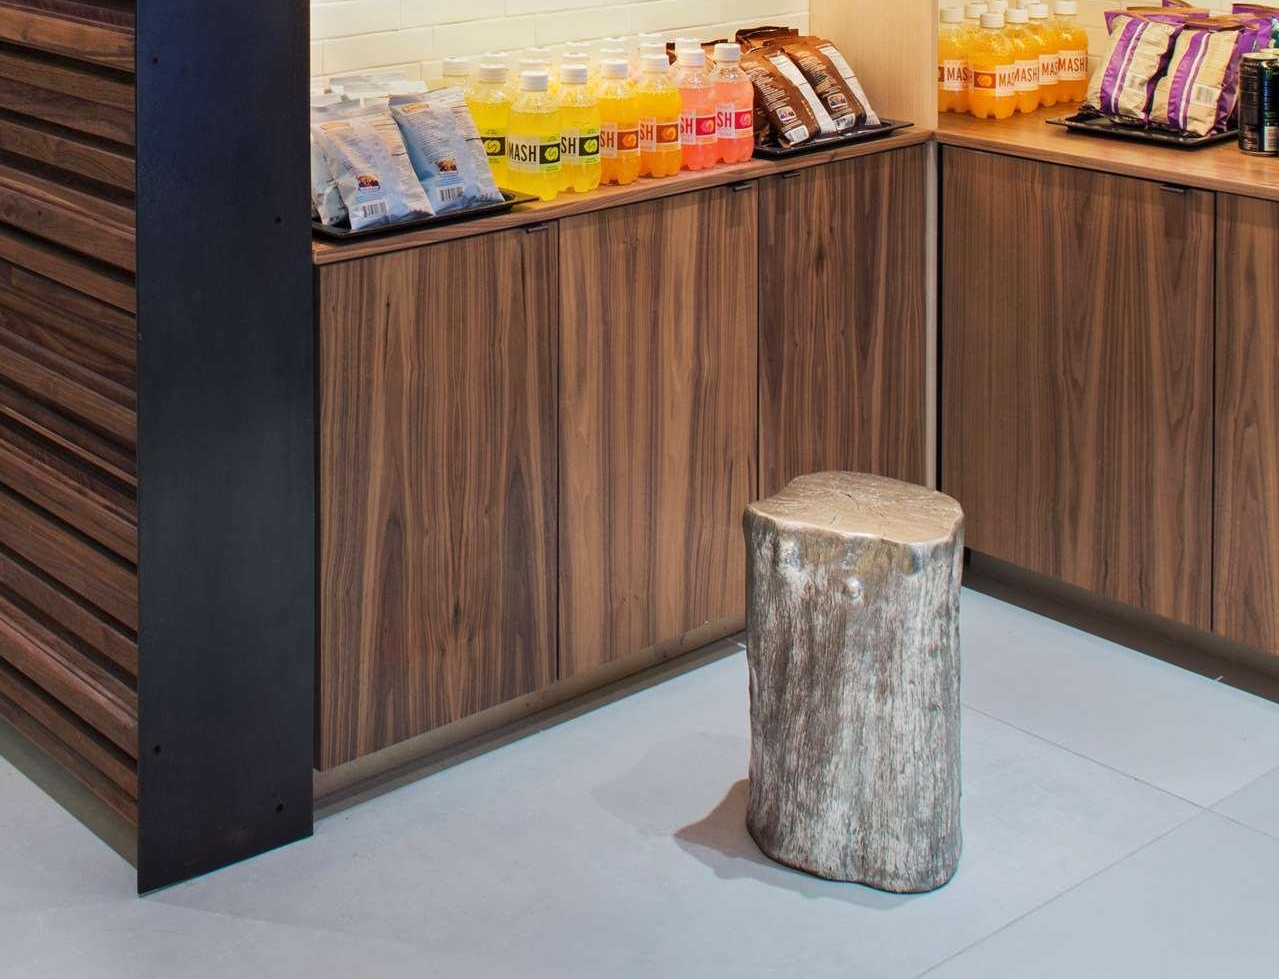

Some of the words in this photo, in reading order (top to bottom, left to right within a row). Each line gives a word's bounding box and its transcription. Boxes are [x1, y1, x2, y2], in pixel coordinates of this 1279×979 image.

[1041, 62, 1058, 76] MAS
[1058, 57, 1085, 72] MASH
[947, 66, 968, 81] MAS
[680, 116, 693, 134] SH
[717, 111, 732, 128] SH
[600, 131, 614, 148] SH
[640, 123, 654, 141] SH
[561, 136, 576, 154] SH
